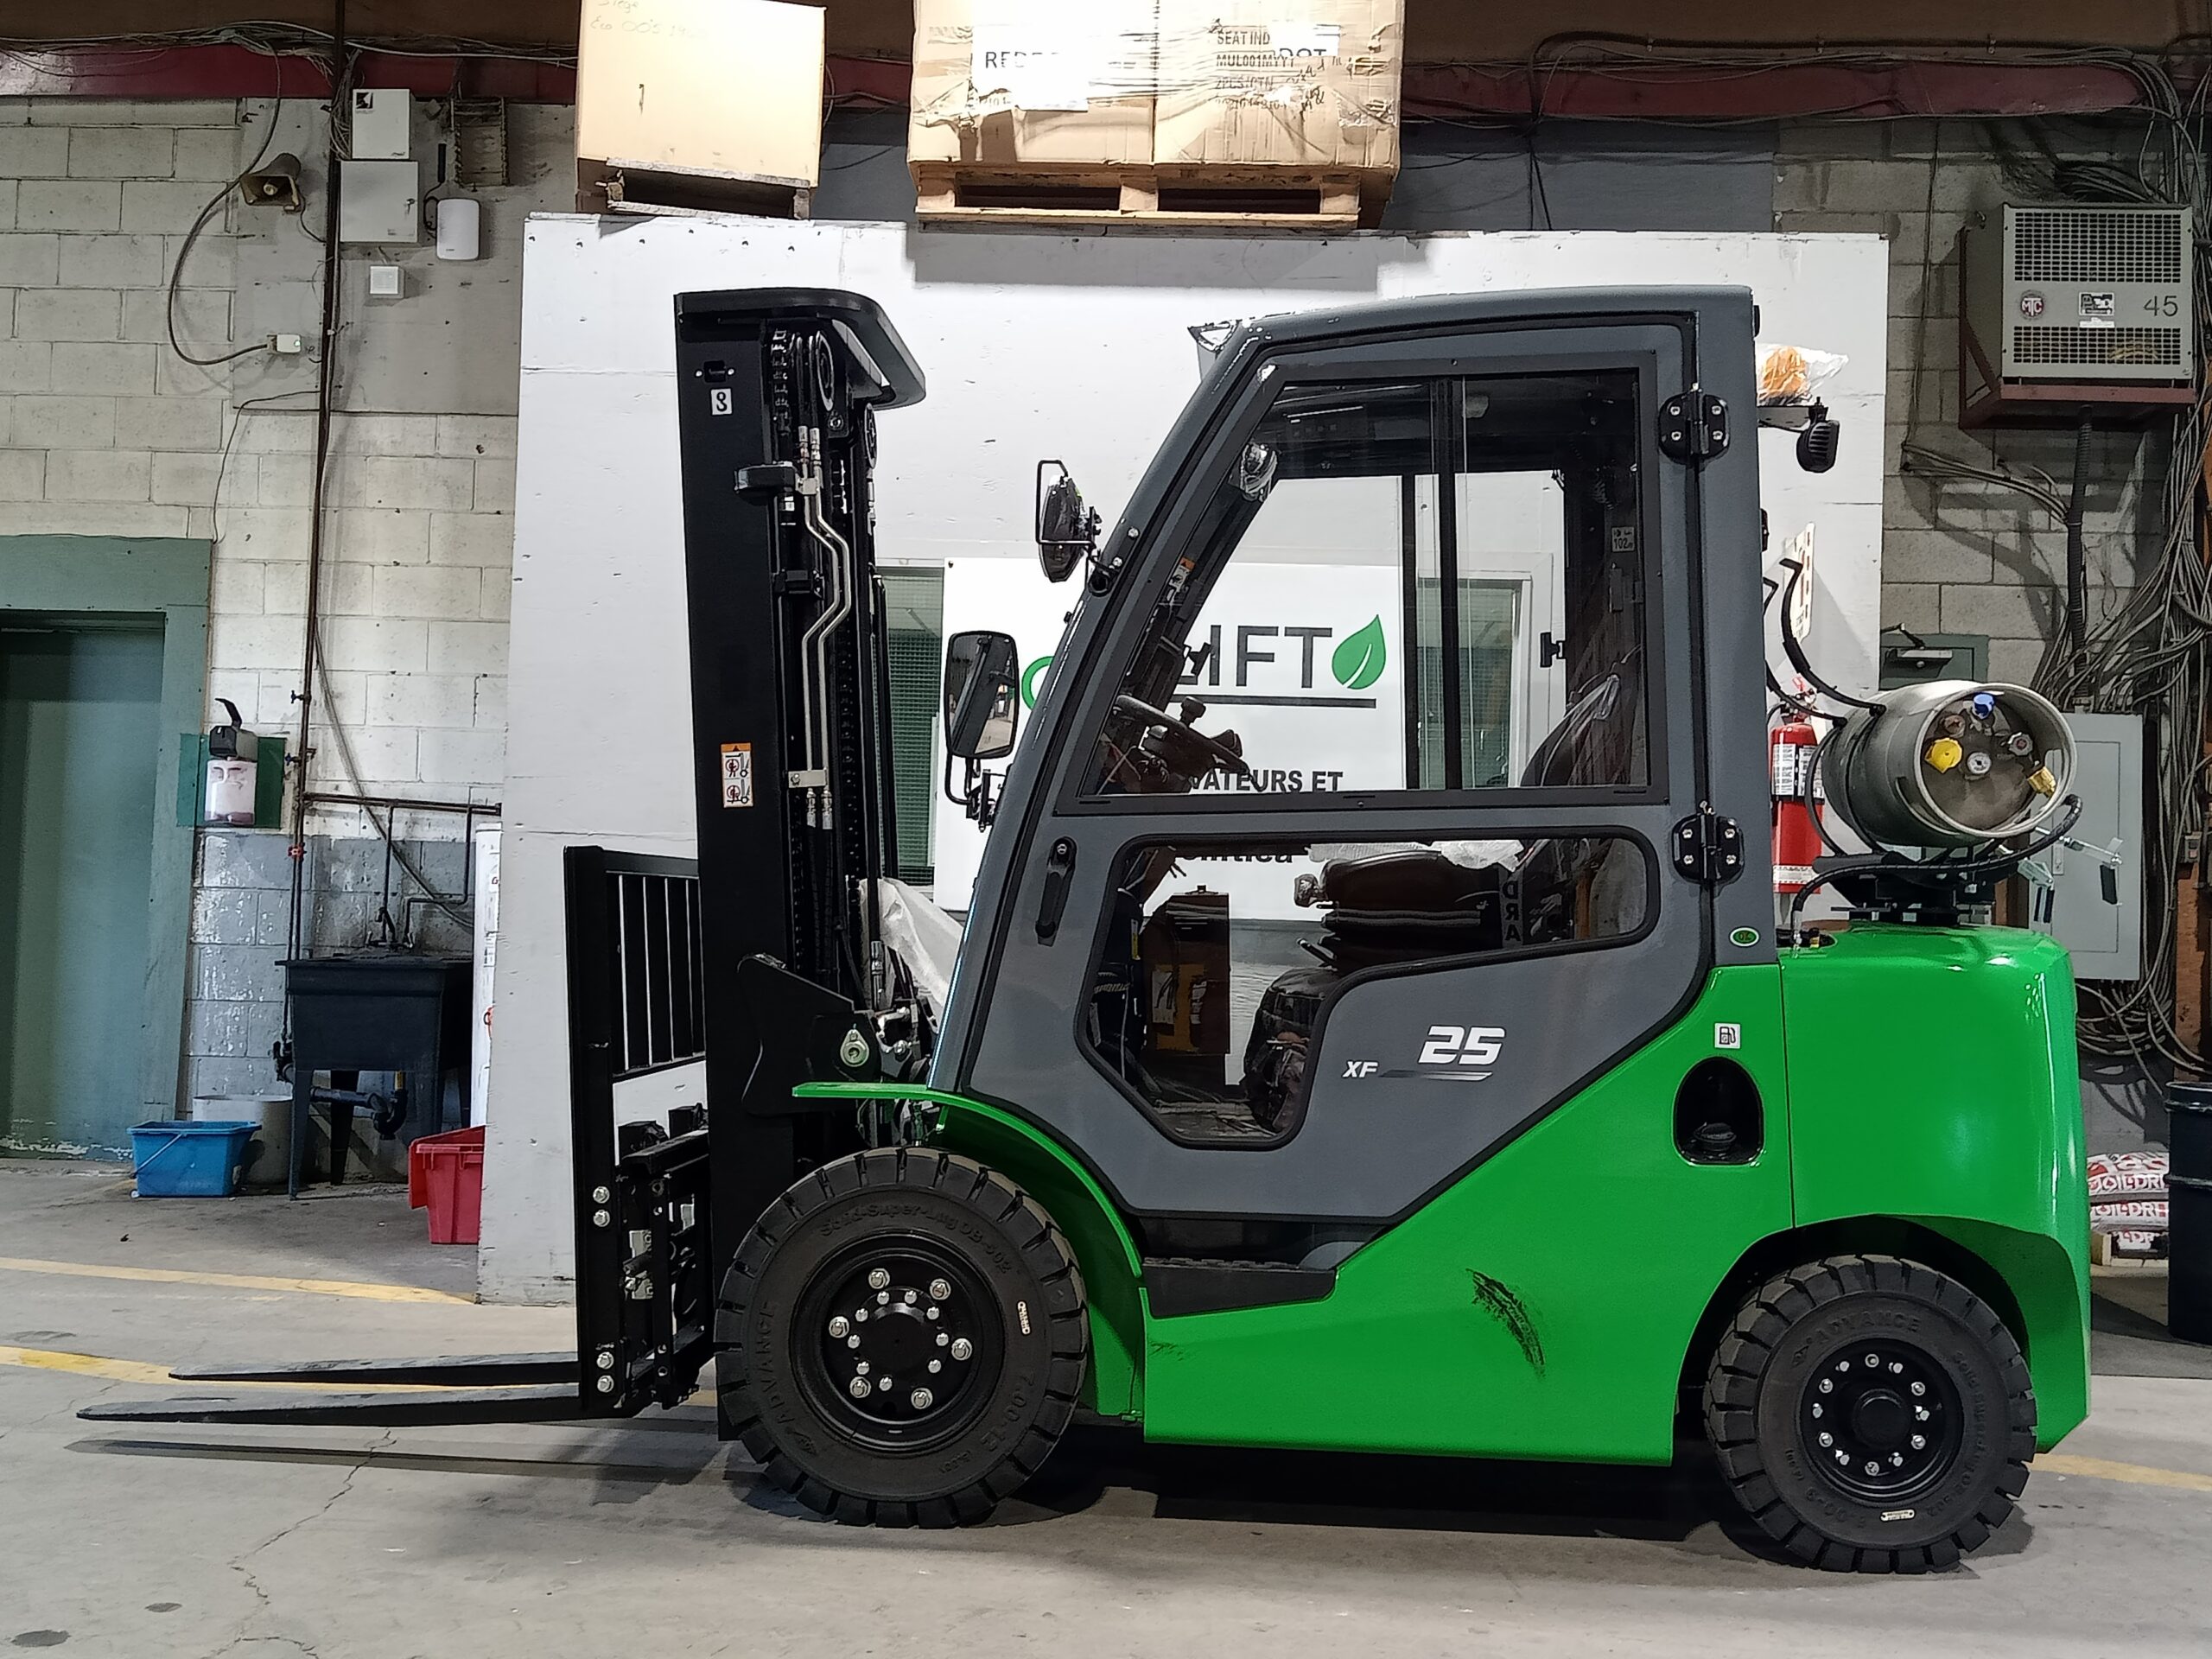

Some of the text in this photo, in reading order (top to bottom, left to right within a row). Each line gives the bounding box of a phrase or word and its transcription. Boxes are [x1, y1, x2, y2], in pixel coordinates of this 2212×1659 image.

[1217, 31, 1247, 45] SEAT
[2022, 297, 2043, 316] MTC
[2144, 295, 2178, 316] 45
[1178, 624, 1333, 689] IFT
[1312, 771, 1344, 792] ET
[1418, 1026, 1505, 1065] 25
[1342, 1061, 1378, 1078] XF
